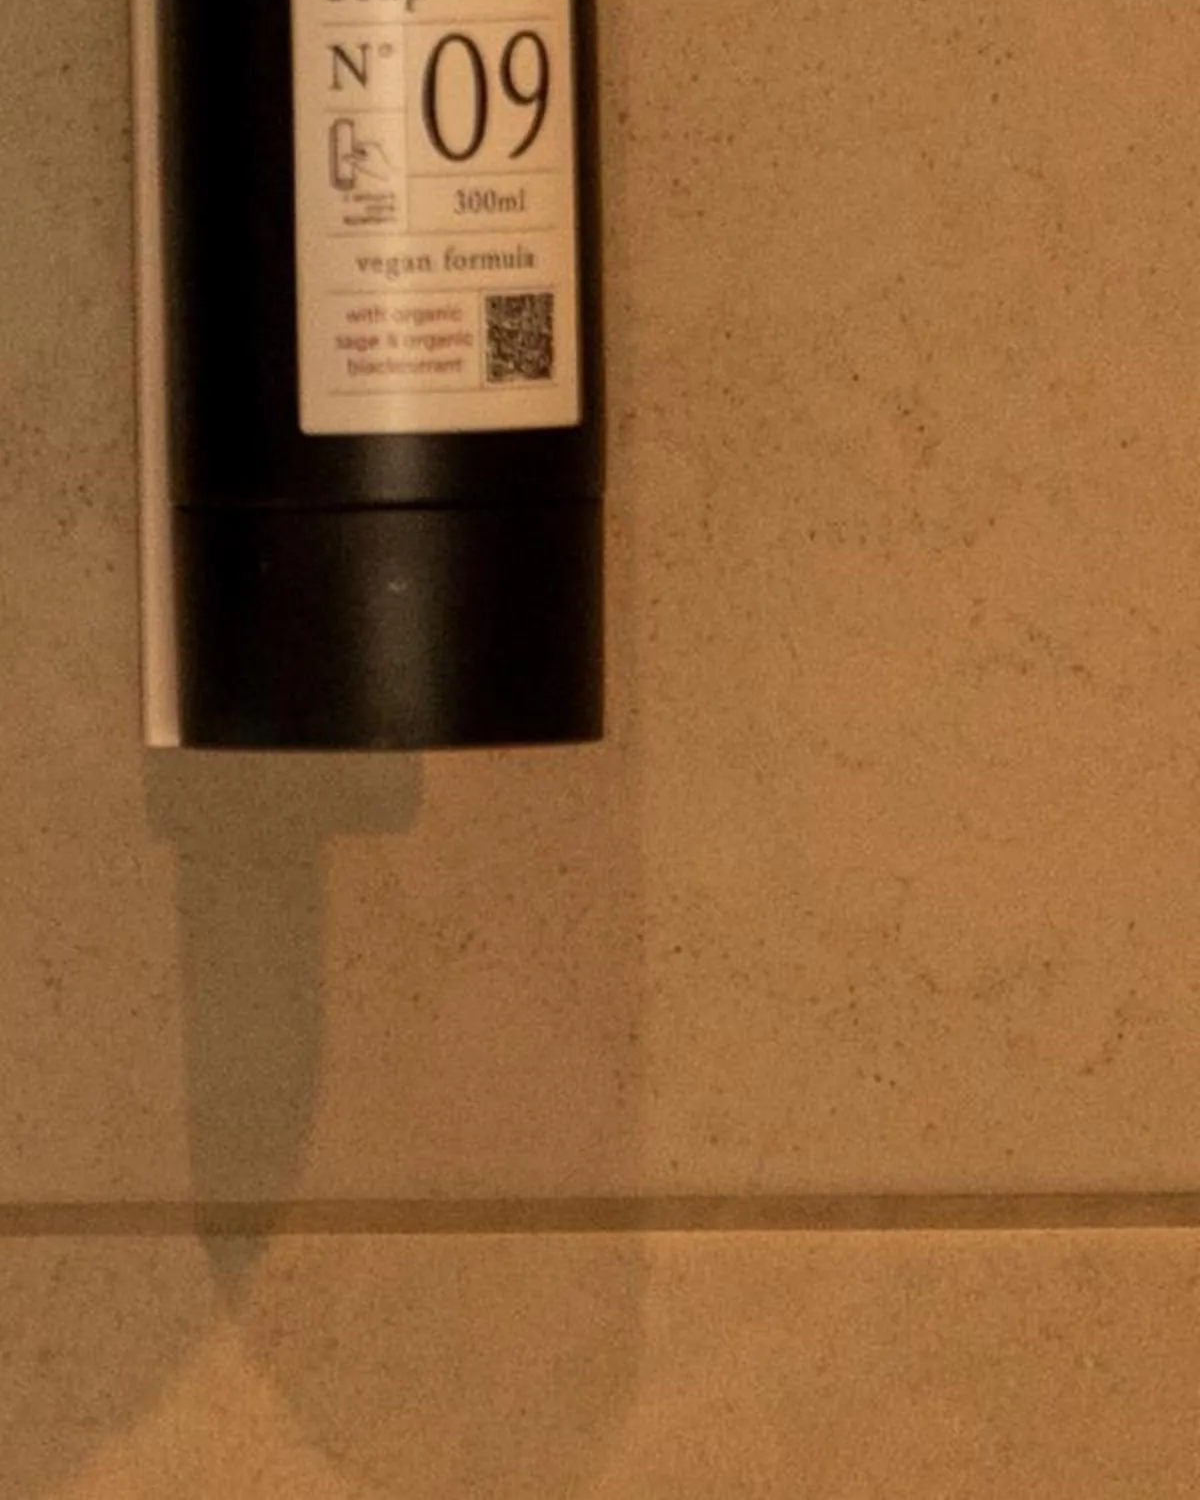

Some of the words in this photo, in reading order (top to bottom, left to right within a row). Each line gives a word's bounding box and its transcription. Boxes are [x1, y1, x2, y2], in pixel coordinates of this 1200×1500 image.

[421, 29, 549, 163] 09
[453, 188, 526, 216] 300ml
[355, 253, 432, 280] vegan
[444, 246, 536, 272] formula
